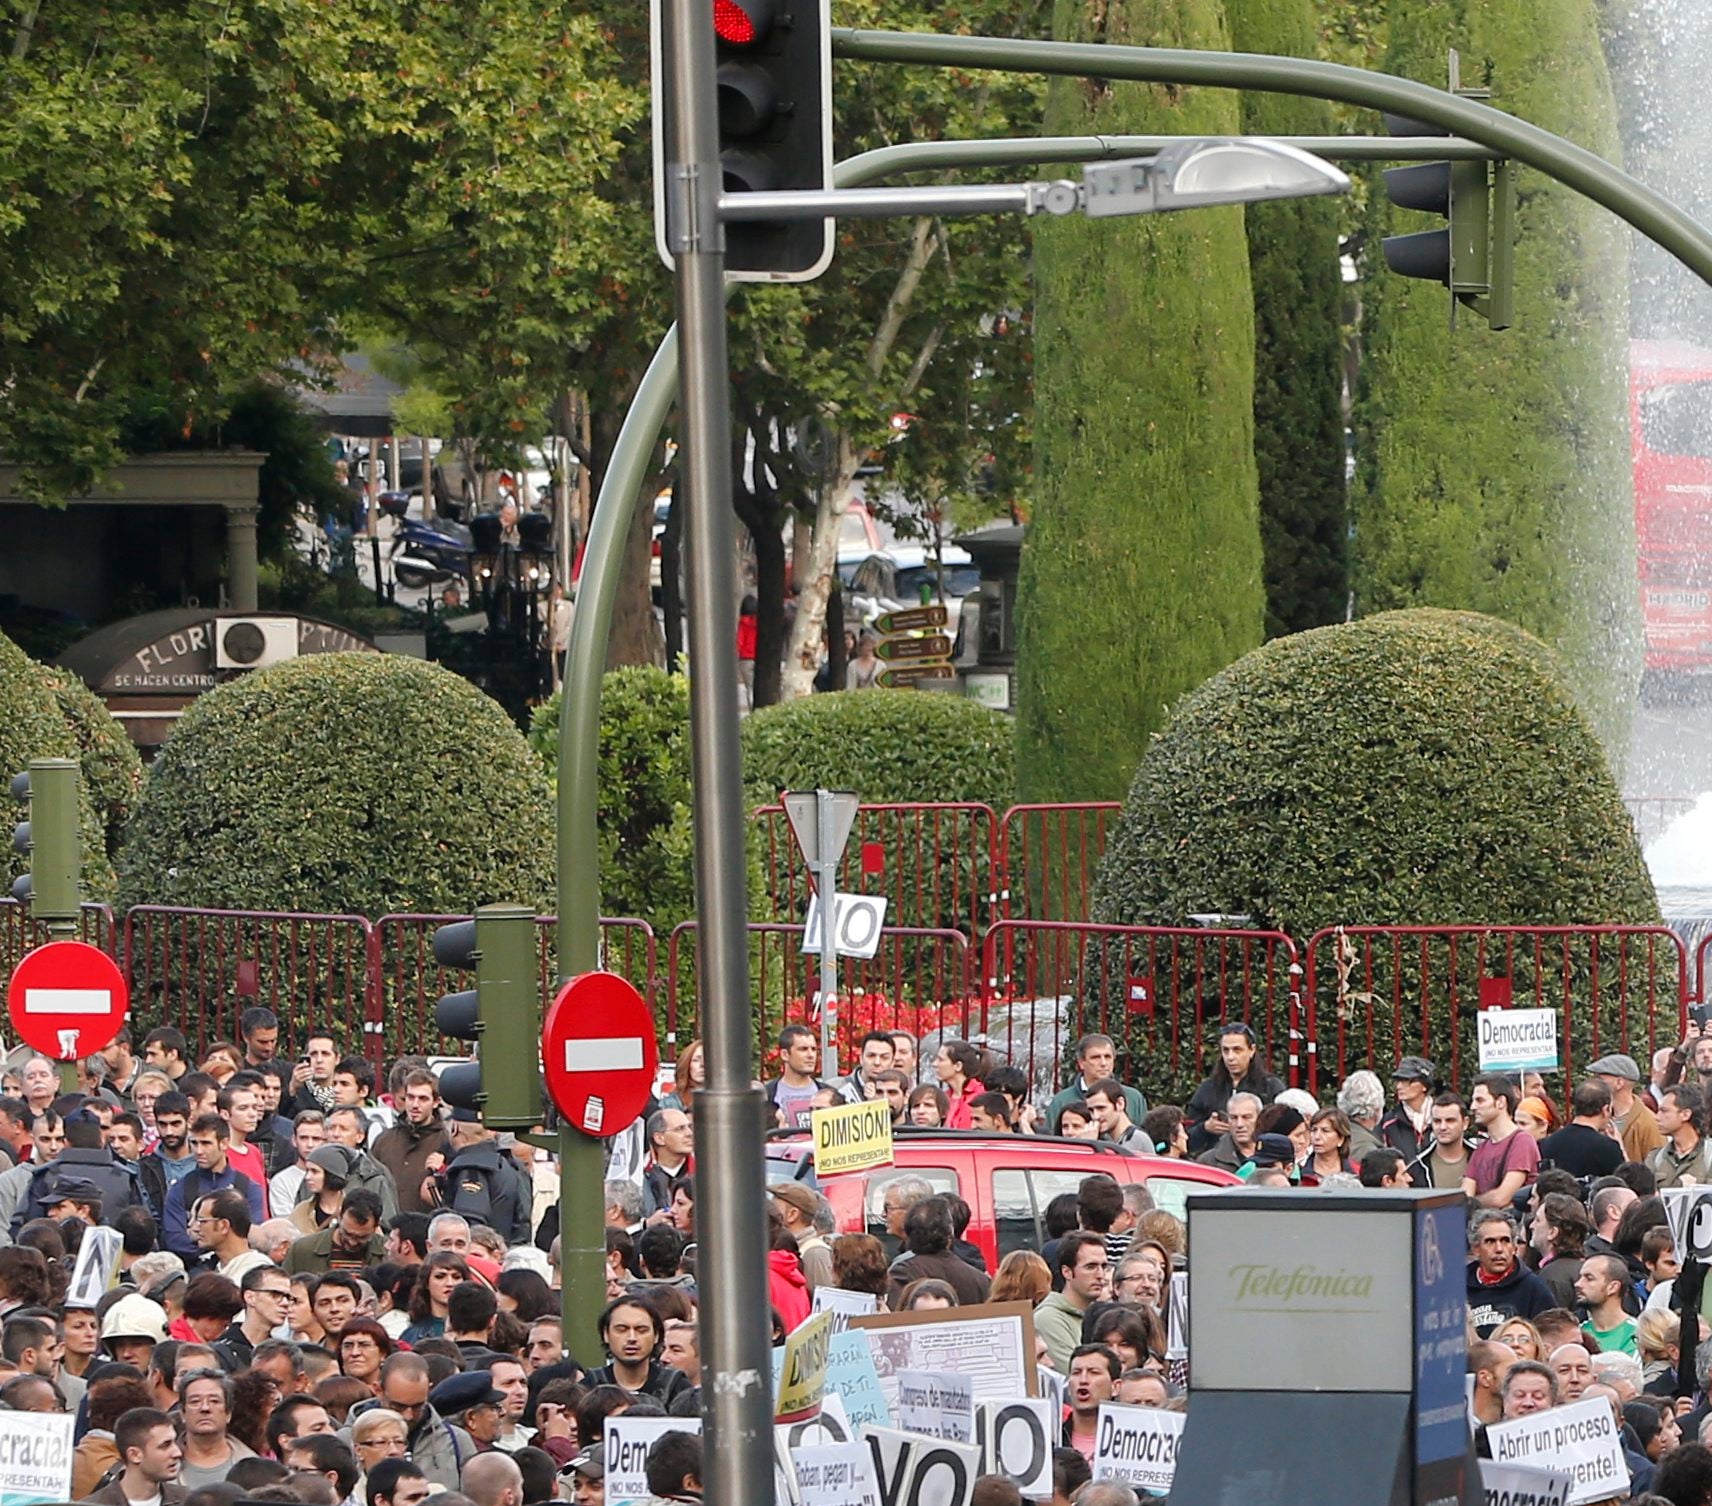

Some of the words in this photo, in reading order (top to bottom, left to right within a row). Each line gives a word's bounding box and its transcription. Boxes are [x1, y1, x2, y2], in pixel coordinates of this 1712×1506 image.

[172, 674, 215, 688] CENTRO
[1483, 1014, 1554, 1045] Democracia!
[820, 1107, 888, 1149] DIMISIÓN!
[1229, 1264, 1374, 1301] Telefónica
[0, 1421, 68, 1469] cracia!
[1100, 1414, 1182, 1465] Democra
[1498, 1429, 1531, 1461] Abrir
[1535, 1429, 1551, 1450] un
[1553, 1414, 1611, 1455] proceso
[1114, 1467, 1131, 1480] NOS
[1132, 1469, 1174, 1485] REPRESE
